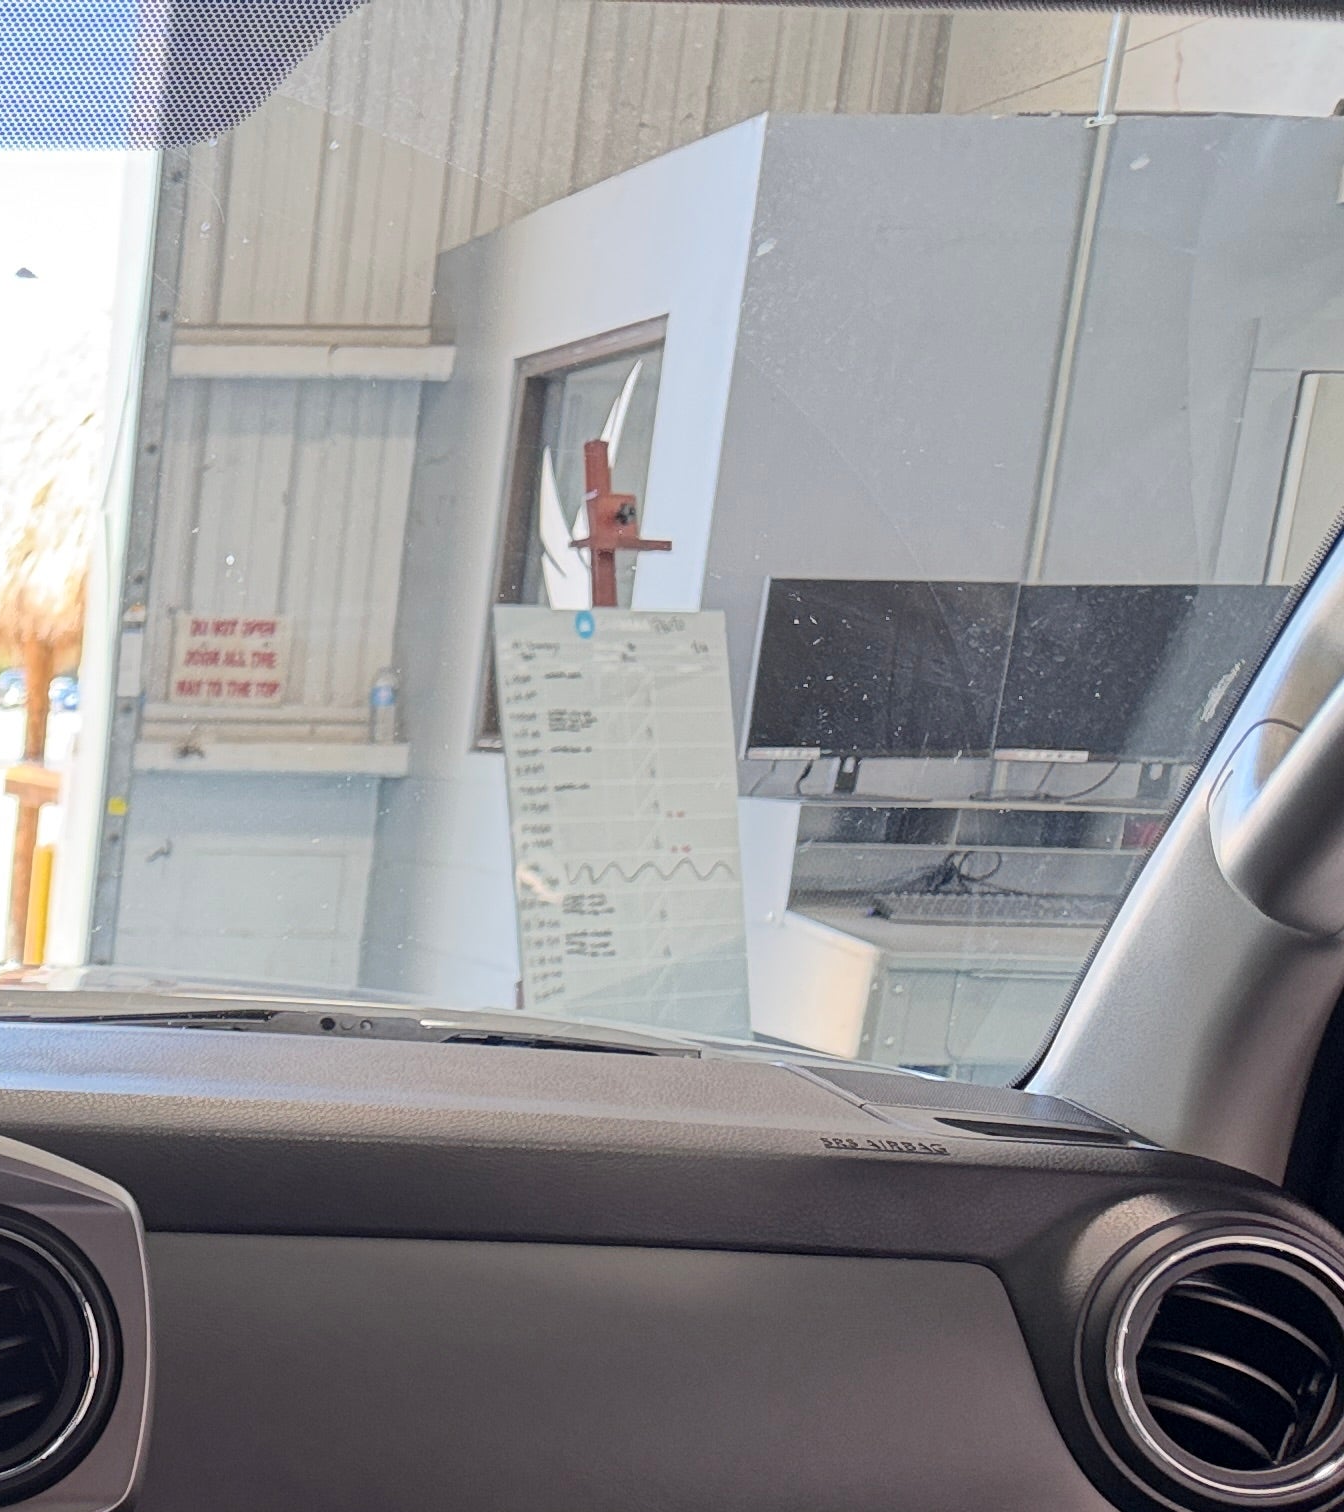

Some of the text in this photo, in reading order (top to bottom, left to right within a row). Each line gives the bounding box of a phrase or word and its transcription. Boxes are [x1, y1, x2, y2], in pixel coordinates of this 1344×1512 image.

[191, 619, 277, 638] DO NOT OPEN
[223, 649, 246, 668] ALL
[252, 649, 277, 669] THE
[208, 678, 223, 697] TO
[226, 679, 251, 698] THE
[255, 680, 281, 698] TOP
[866, 1139, 949, 1154] AIRBAG
